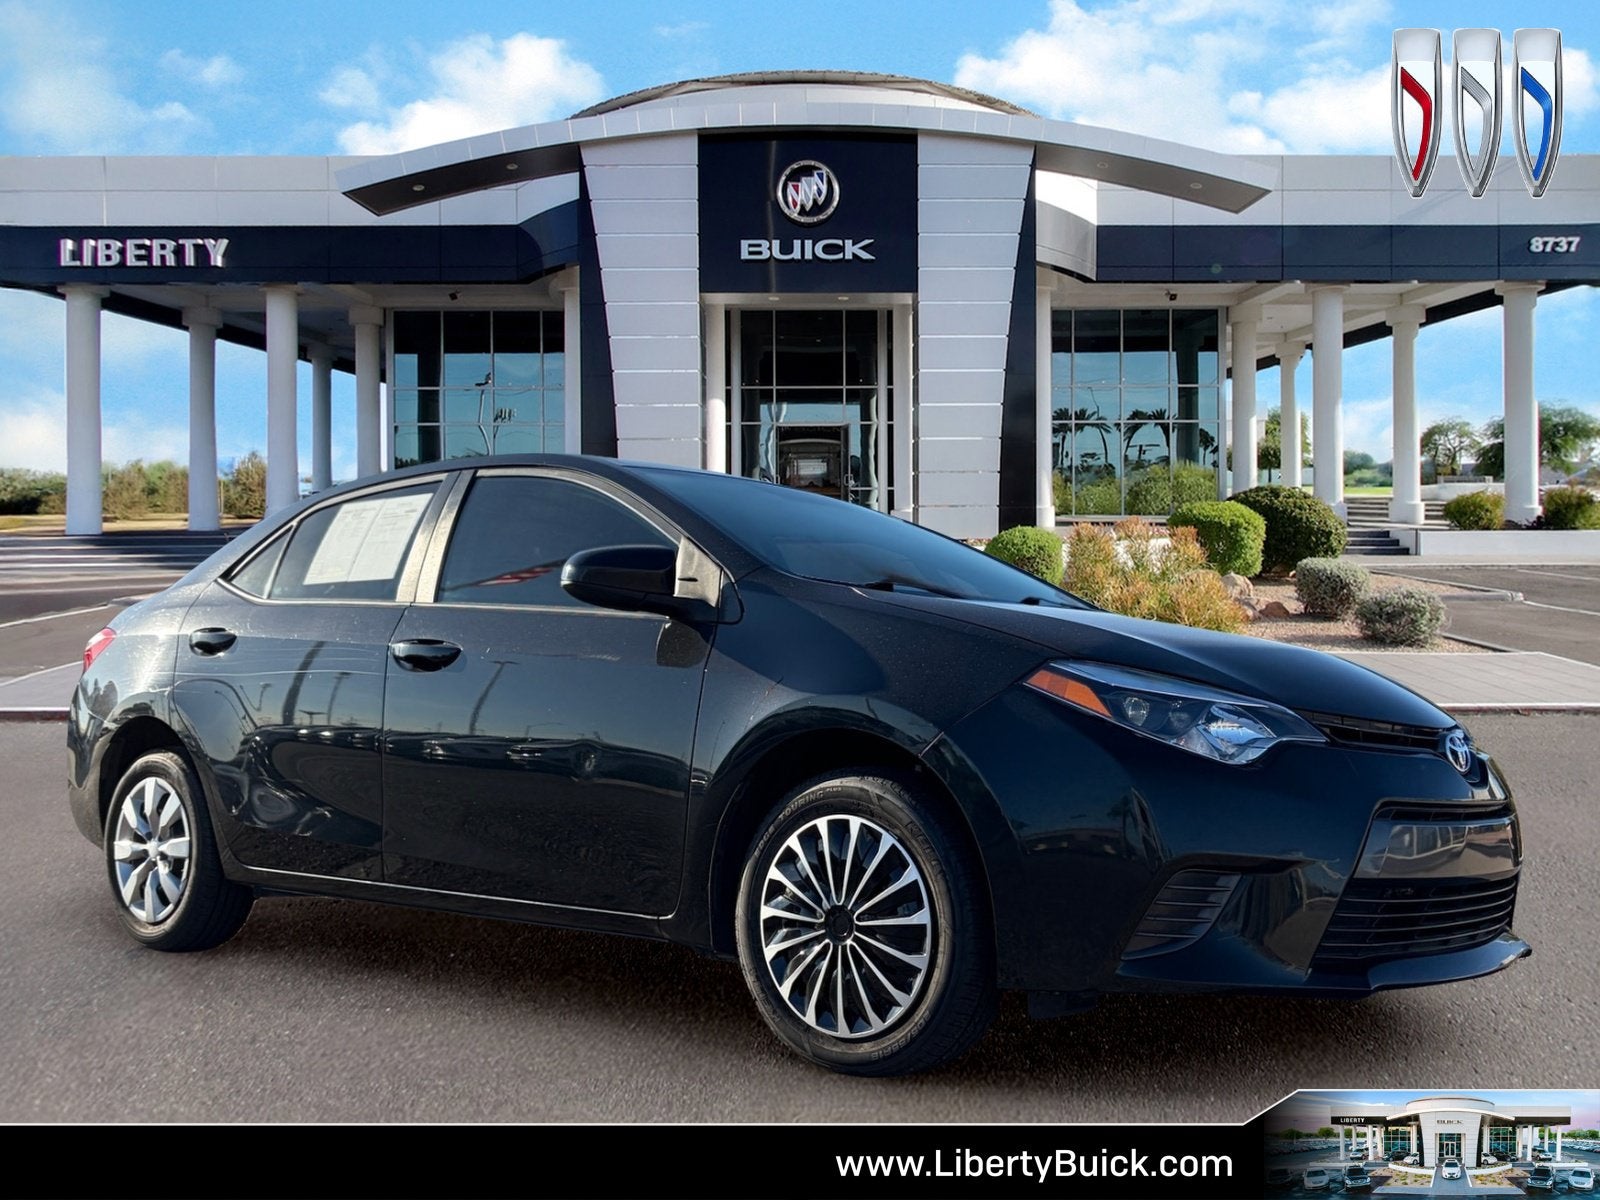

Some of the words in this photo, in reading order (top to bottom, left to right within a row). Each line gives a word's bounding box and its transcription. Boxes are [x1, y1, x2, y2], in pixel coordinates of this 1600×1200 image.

[58, 238, 229, 268] LIBERTY
[740, 239, 876, 260] BUICK
[1529, 236, 1581, 253] 8737
[779, 790, 825, 821] TOURING
